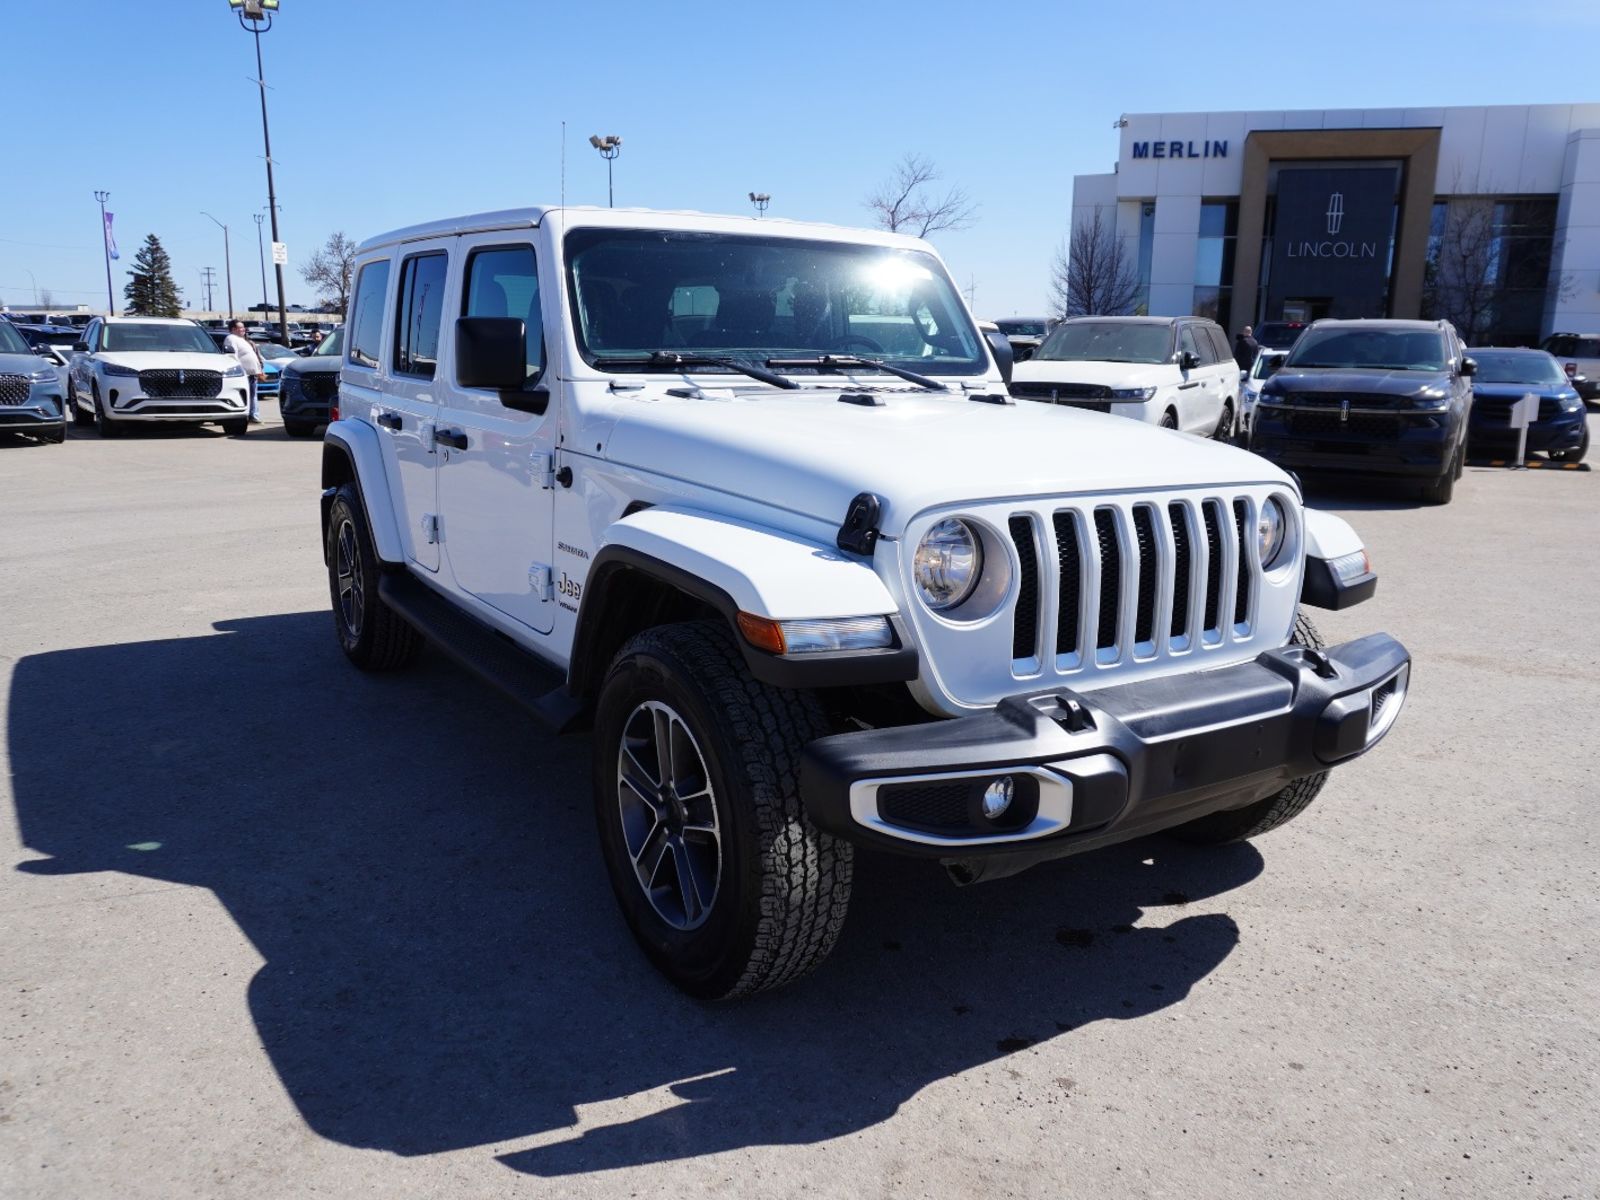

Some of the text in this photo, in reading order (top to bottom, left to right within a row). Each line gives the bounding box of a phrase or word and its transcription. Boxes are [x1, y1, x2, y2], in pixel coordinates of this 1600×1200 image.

[1132, 140, 1228, 159] MERLIN
[1287, 241, 1376, 258] LINCOLN
[558, 571, 582, 600] Jee
